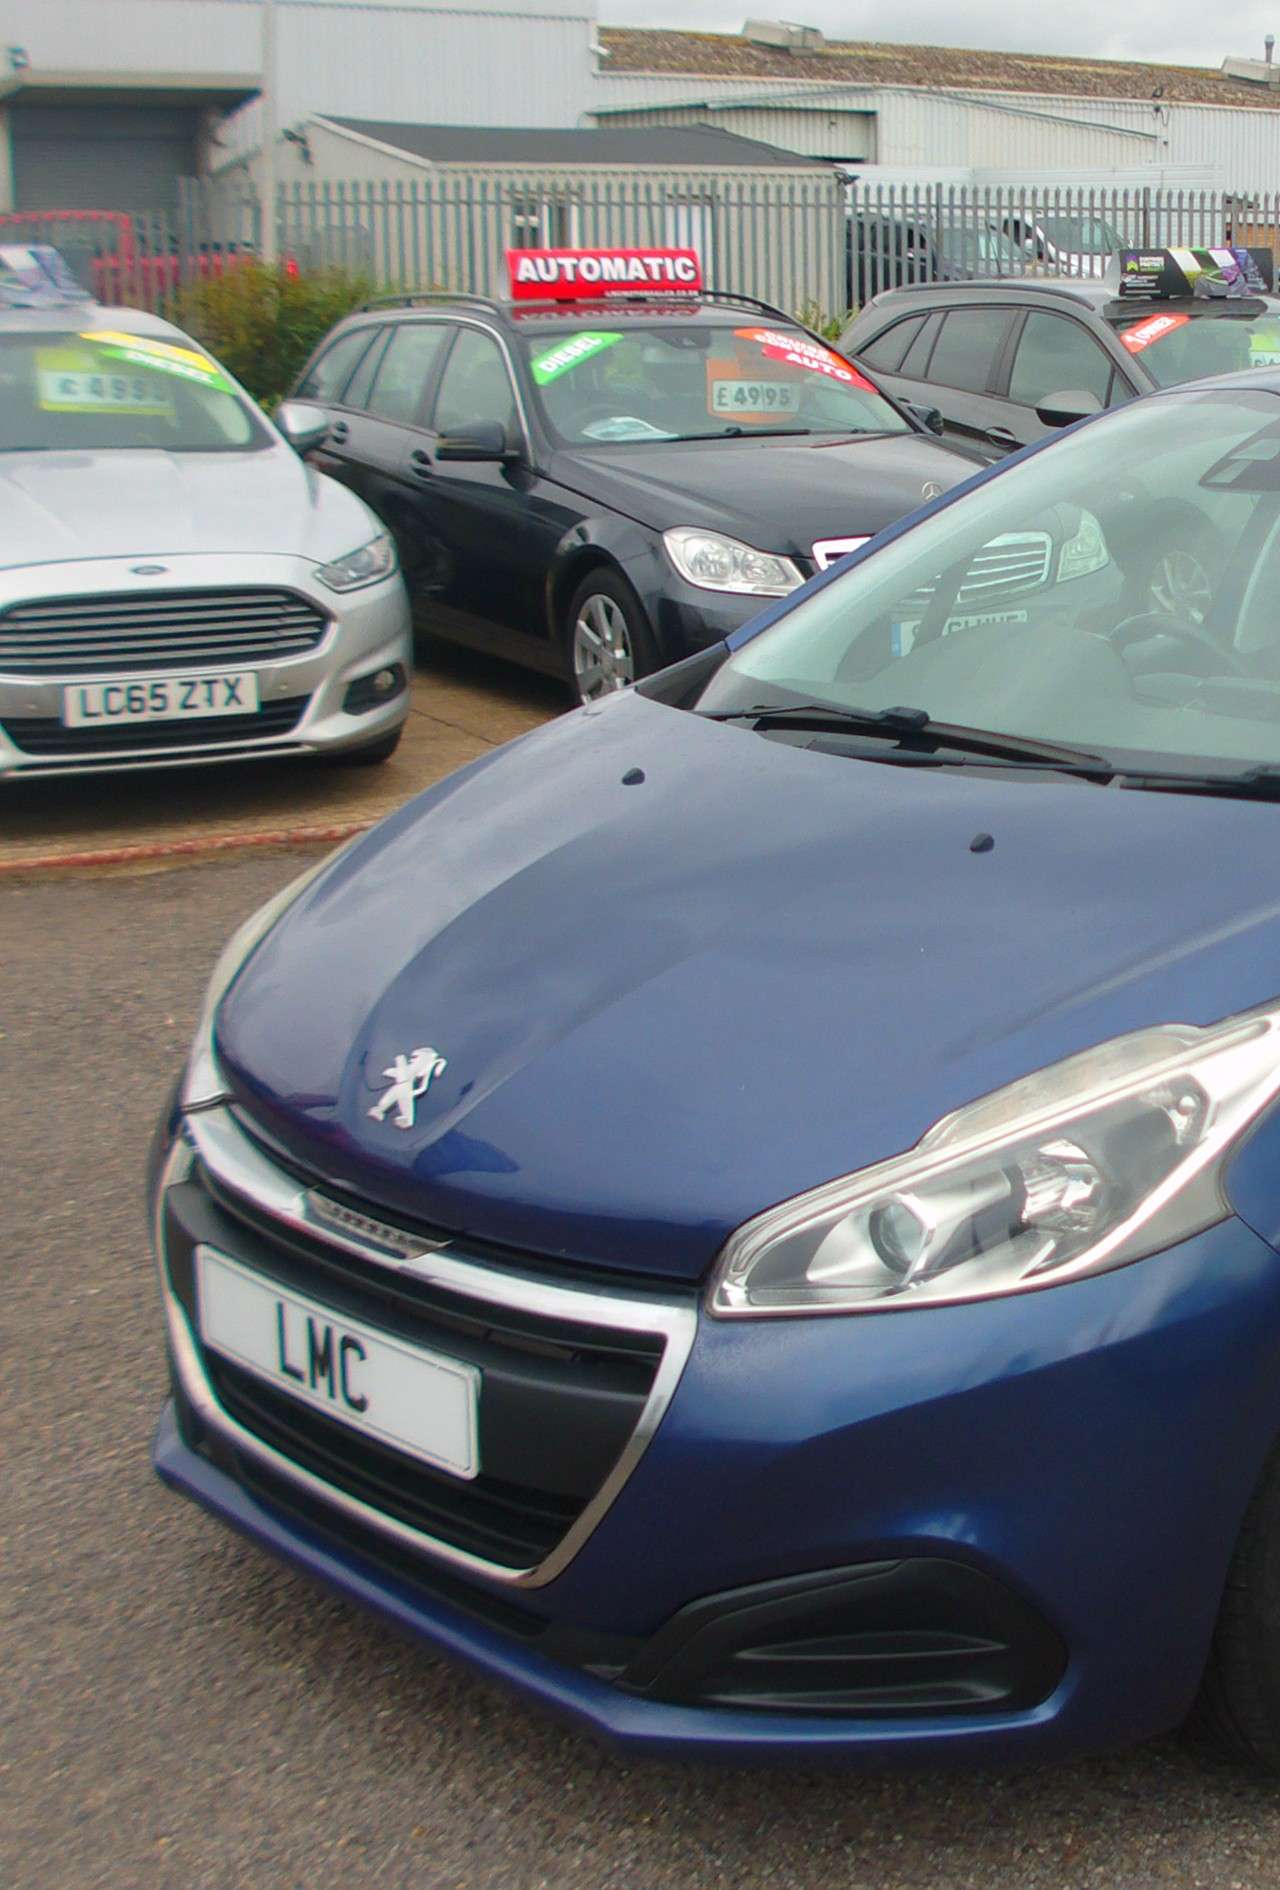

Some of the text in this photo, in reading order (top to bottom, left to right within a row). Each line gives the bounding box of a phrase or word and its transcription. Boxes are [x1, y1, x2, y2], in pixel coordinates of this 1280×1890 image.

[517, 256, 697, 283] AUTOMATIC
[785, 353, 853, 381] AUTO
[716, 384, 791, 407] £4995
[80, 676, 243, 718] LC65 ZTX
[276, 1300, 368, 1413] LMC
